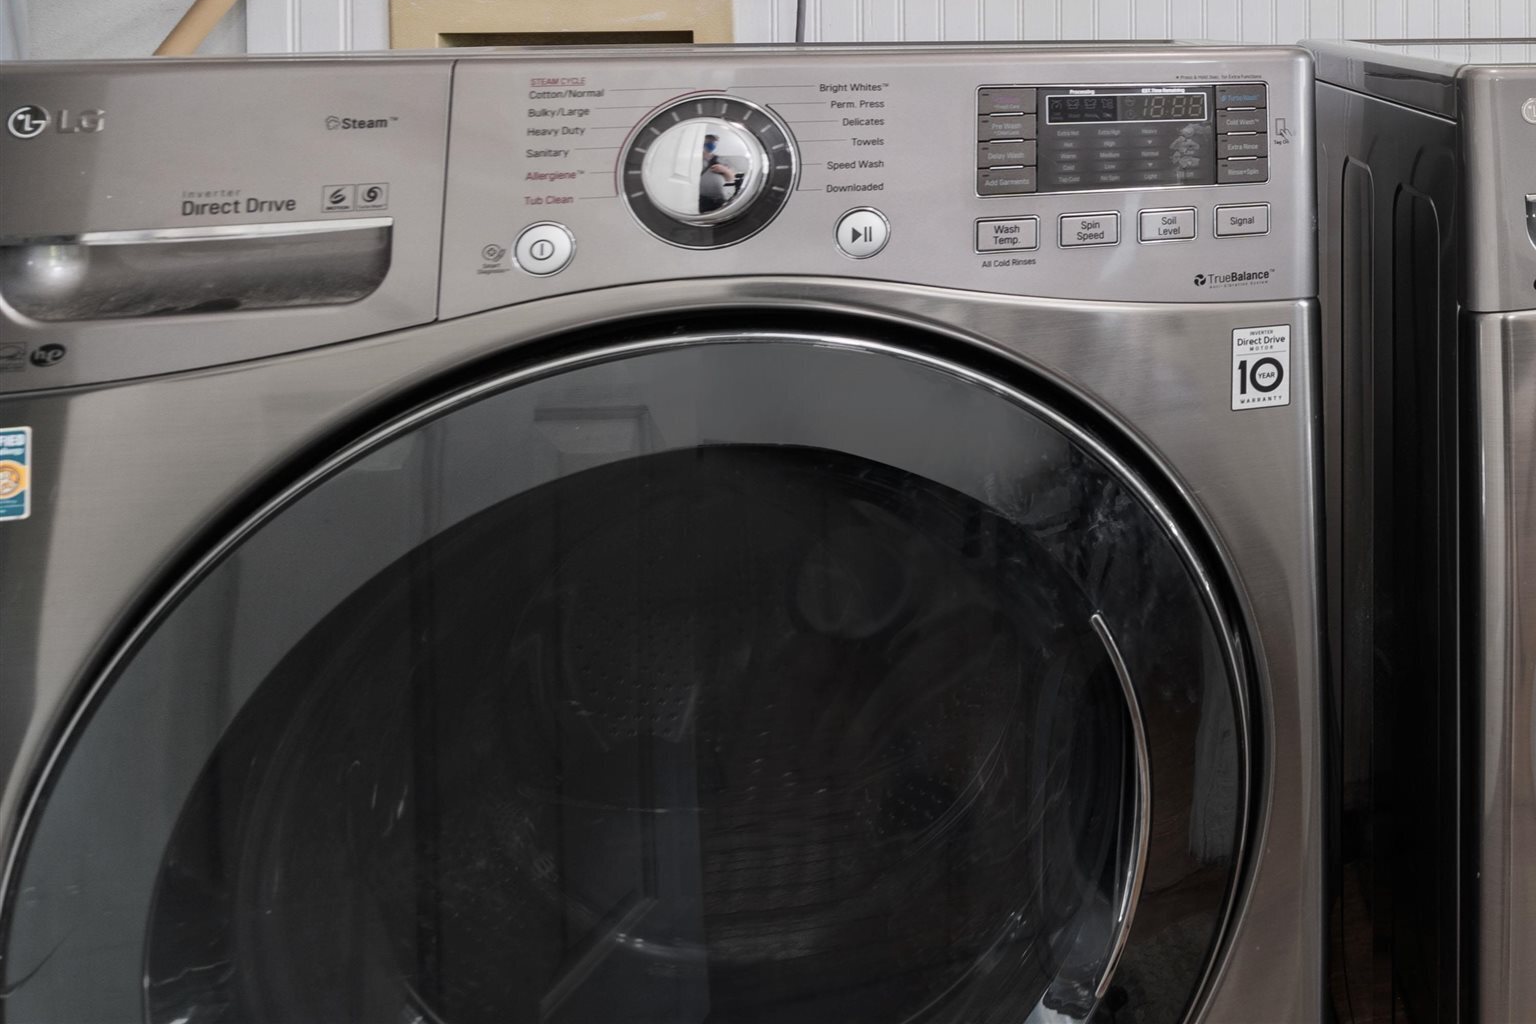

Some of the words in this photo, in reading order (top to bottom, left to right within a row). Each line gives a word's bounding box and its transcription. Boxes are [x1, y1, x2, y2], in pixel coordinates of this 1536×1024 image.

[531, 78, 559, 86] STEAM
[561, 77, 586, 86] CYCLE
[819, 83, 847, 93] Bright
[528, 88, 605, 100] Cotton/Normal
[831, 100, 857, 109] Perm.
[859, 100, 885, 108] Press
[528, 107, 590, 117] Bulky/Large
[57, 108, 105, 134] LG
[842, 117, 885, 126] Delicates
[527, 127, 559, 137] Heavy
[561, 126, 586, 136] Duty
[852, 137, 885, 146] Towels
[526, 149, 570, 159] Sanitary
[827, 161, 856, 170] Speed
[858, 160, 884, 169] Wash
[1000, 178, 1030, 186] Garments
[826, 183, 884, 192] Downloaded
[524, 195, 542, 205] Tub
[545, 195, 574, 205] Clean
[181, 199, 241, 216] Direct
[246, 197, 297, 214] Drive
[1161, 216, 1177, 225] Soil
[1230, 216, 1255, 226] Signal
[994, 224, 1020, 234] Wash
[1081, 221, 1100, 231] Spin
[1158, 226, 1180, 236] Level
[993, 236, 1021, 245] Temp.
[1077, 231, 1105, 242] Speed
[982, 260, 992, 268] All
[993, 259, 1010, 267] Cold
[1012, 258, 1037, 266] Rinses
[1237, 337, 1262, 346] Direct
[1264, 335, 1285, 344] Drive
[1238, 357, 1284, 395] 10
[1258, 371, 1275, 379] YEAR
[1240, 395, 1282, 404] WARRANTY
